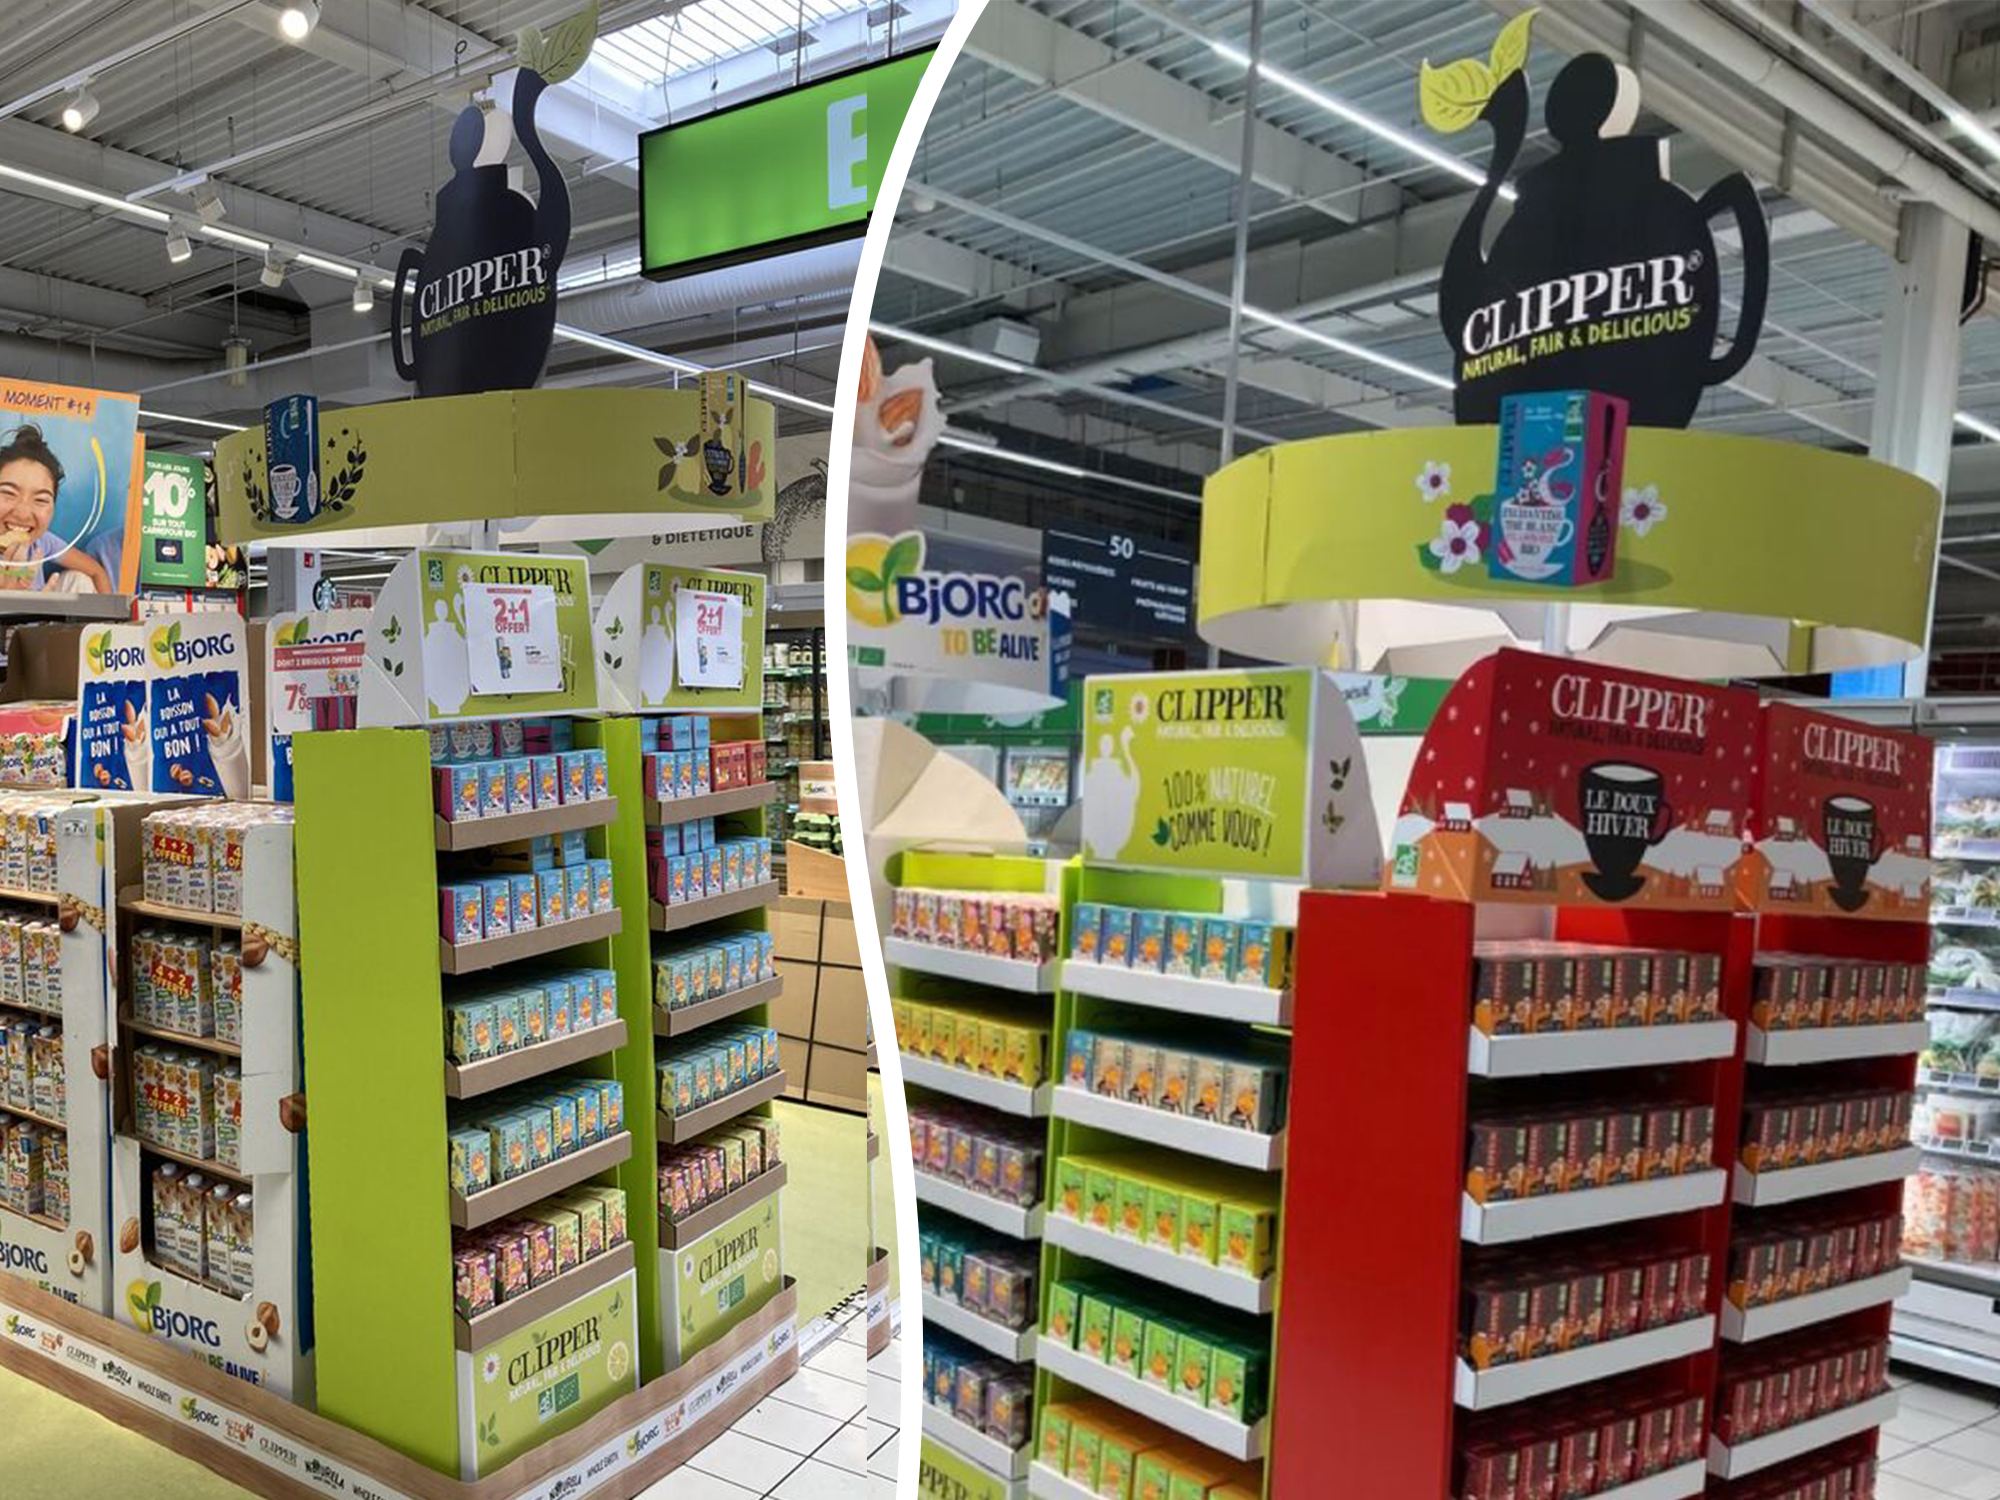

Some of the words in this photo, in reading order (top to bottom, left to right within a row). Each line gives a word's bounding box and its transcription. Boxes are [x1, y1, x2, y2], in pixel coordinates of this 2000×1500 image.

[482, 285, 547, 314] DELICIOUS
[1462, 345, 1528, 381] NATURAL,
[1530, 333, 1564, 358] FAIR
[1569, 330, 1583, 346] &
[1588, 307, 1692, 344] DELICIOUS
[4, 390, 65, 411] MOMENT
[652, 534, 662, 546] &
[1108, 535, 1134, 559] 50
[492, 597, 532, 622] 2+1
[697, 603, 724, 631] 2+1
[494, 621, 531, 634] OFFERT
[941, 628, 968, 655] TO
[973, 628, 998, 655] BE
[999, 633, 1040, 661] ALIVE
[96, 692, 106, 705] LA
[167, 688, 181, 701] LA
[1157, 685, 1287, 722] CLIPPER
[1552, 673, 1707, 738] CLIPPER
[159, 700, 195, 721] BOISSON
[96, 726, 102, 738] A
[103, 721, 121, 735] TOUT
[170, 724, 178, 736] A
[179, 716, 200, 732] TOUT
[90, 737, 112, 758] BON
[164, 736, 191, 759] BON
[1803, 722, 1900, 775] CLIPPER
[1584, 789, 1611, 810] LE
[1613, 791, 1657, 815] DOUX
[1169, 808, 1216, 851] COMME
[1587, 813, 1649, 839] HIVER
[181, 842, 188, 855] 2
[1829, 838, 1871, 860] HIVER
[179, 975, 186, 986] 2
[173, 1094, 181, 1105] 2
[699, 1226, 759, 1284] CLIPPER
[508, 1316, 600, 1387] CLIPPER
